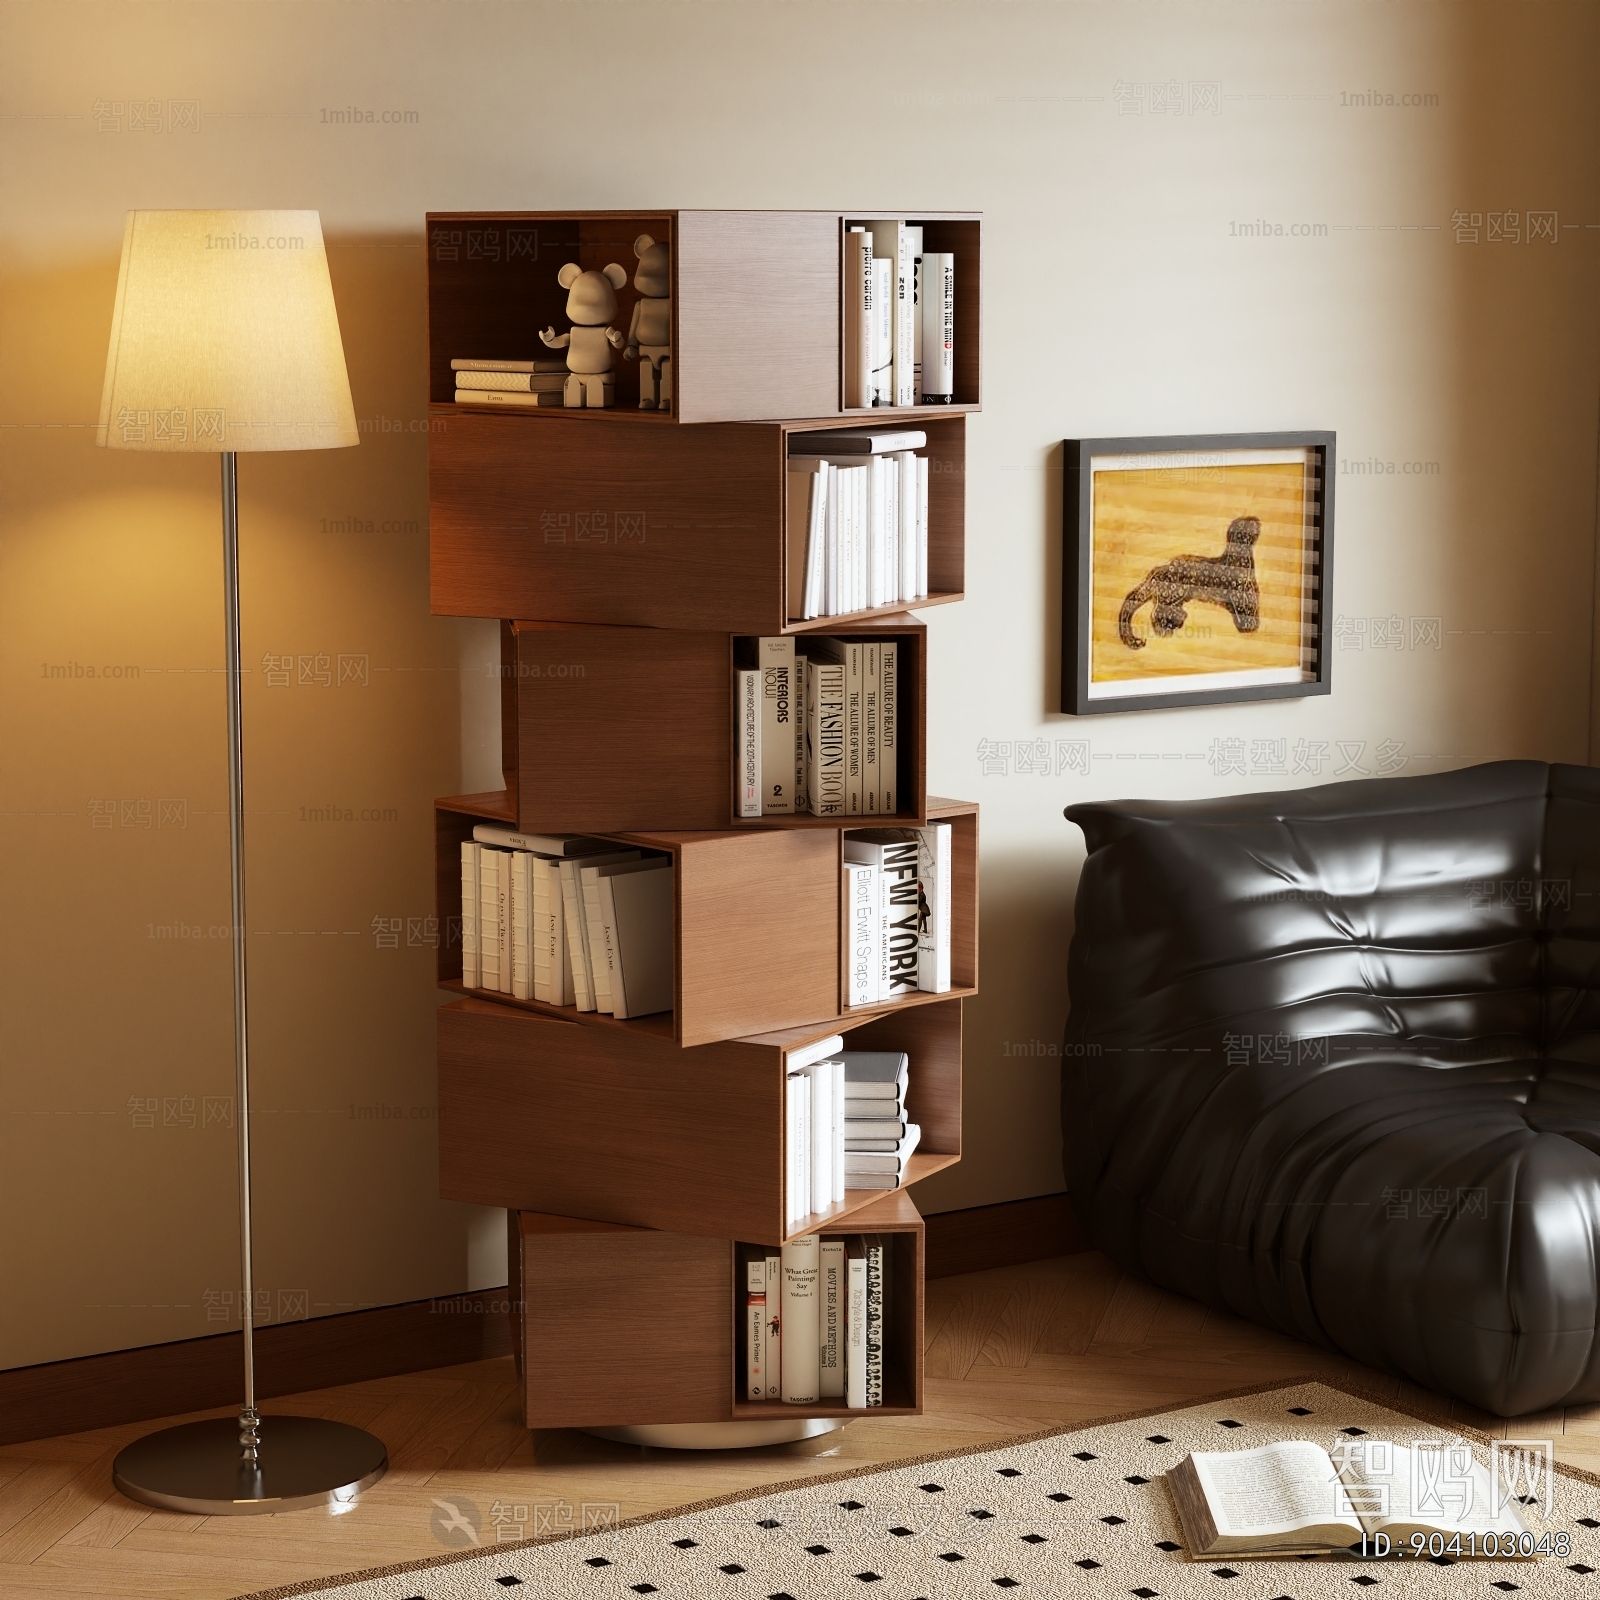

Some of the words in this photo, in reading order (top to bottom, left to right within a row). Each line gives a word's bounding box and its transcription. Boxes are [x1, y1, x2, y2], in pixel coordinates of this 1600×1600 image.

[861, 246, 872, 276] pierre
[864, 279, 872, 310] cardin
[944, 275, 953, 299] SMILE
[944, 301, 953, 309] IN
[944, 311, 953, 326] THE
[944, 327, 953, 349] MIND
[884, 652, 894, 670] THE
[746, 675, 755, 697] VISIONARY
[765, 667, 777, 699] NOW!
[820, 666, 843, 699] THE
[884, 670, 894, 702] ALLURE
[777, 667, 789, 724] INTERIORS
[850, 692, 859, 707] THE
[867, 691, 876, 707] THE
[746, 697, 755, 731] ARCHITECTURE
[884, 703, 894, 715] OF
[850, 708, 859, 737] ALLURE
[867, 708, 876, 736] ALLURE
[884, 716, 894, 749] BEAUTY
[746, 731, 755, 739] OF
[746, 739, 755, 749] THE
[820, 702, 844, 767] FASHION
[850, 737, 859, 748] OF
[867, 736, 876, 747] OF
[746, 749, 755, 762] 20TH
[850, 748, 859, 777] WOMEN
[867, 747, 876, 764] MEN
[746, 762, 755, 786] CENTURY
[773, 785, 782, 796] 2
[820, 771, 844, 814] BOOK
[857, 869, 871, 904] Elliott
[857, 906, 871, 944] Erwitt
[854, 946, 871, 988] Snaps
[787, 1275, 816, 1283] Paintings
[827, 1267, 836, 1304] MOVIES
[853, 1288, 862, 1300] 70s
[753, 1311, 760, 1321] An
[827, 1305, 836, 1325] AND
[851, 1300, 862, 1316] Style
[827, 1325, 836, 1369] METHODS
[851, 1323, 862, 1347] Design
